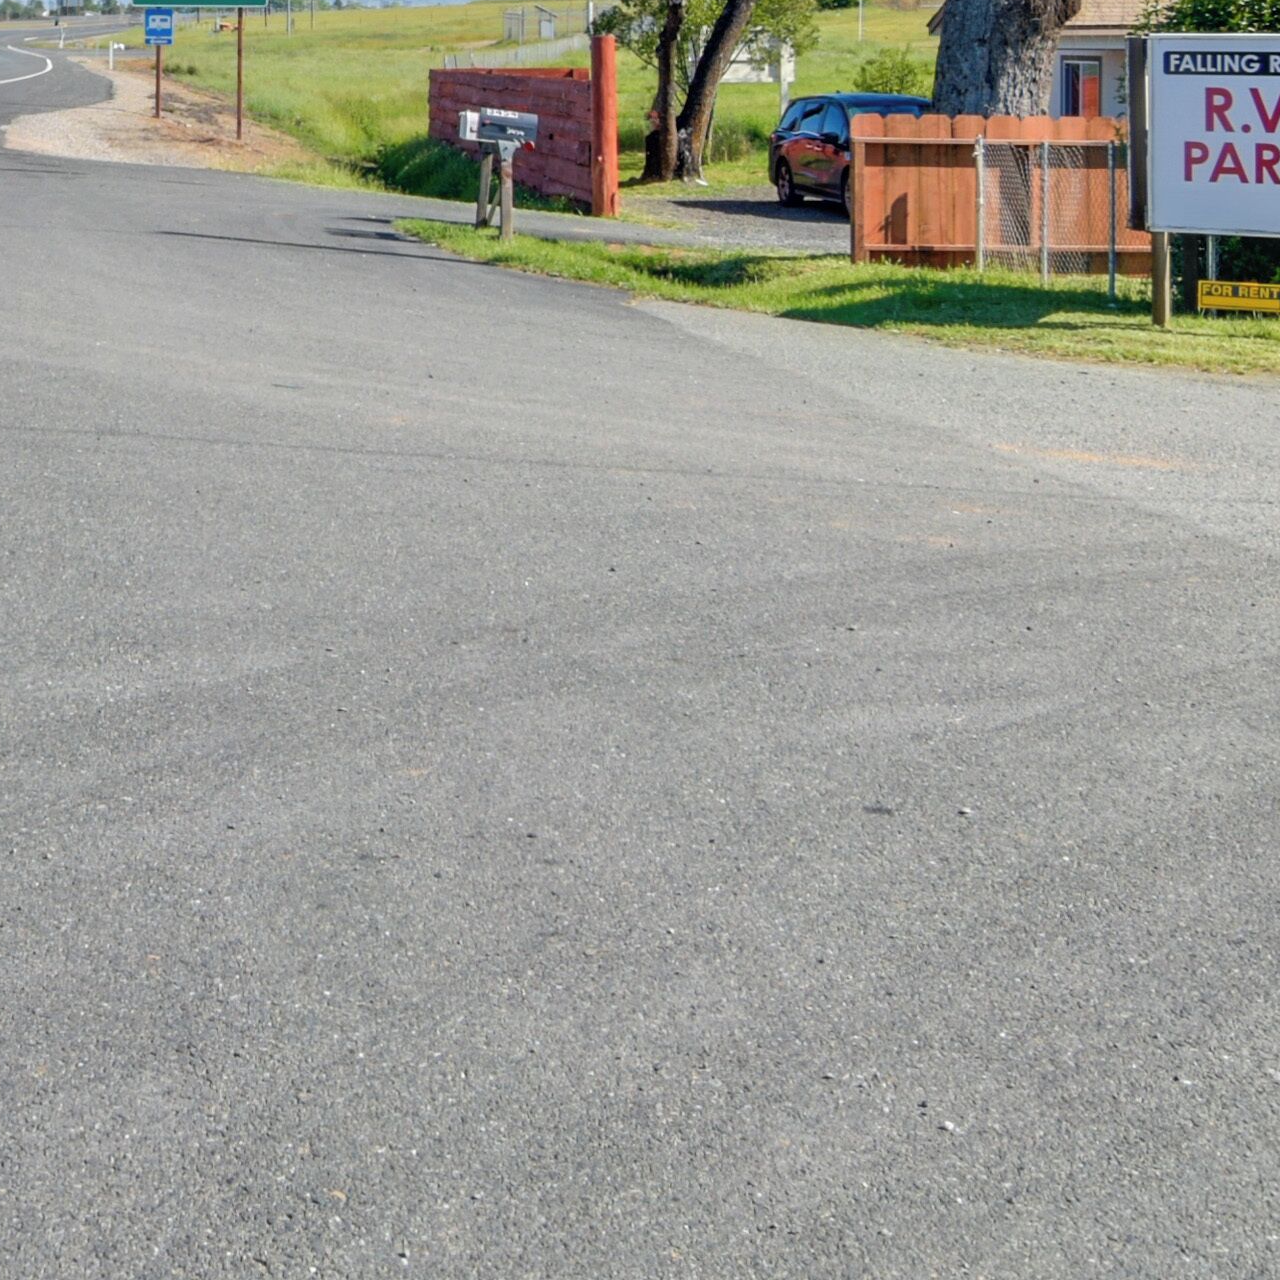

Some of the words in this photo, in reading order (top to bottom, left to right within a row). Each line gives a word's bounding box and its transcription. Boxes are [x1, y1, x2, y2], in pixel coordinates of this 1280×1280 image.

[1169, 54, 1261, 74] FALLING
[1202, 284, 1232, 297] FOR
[1239, 285, 1280, 299] RENT
